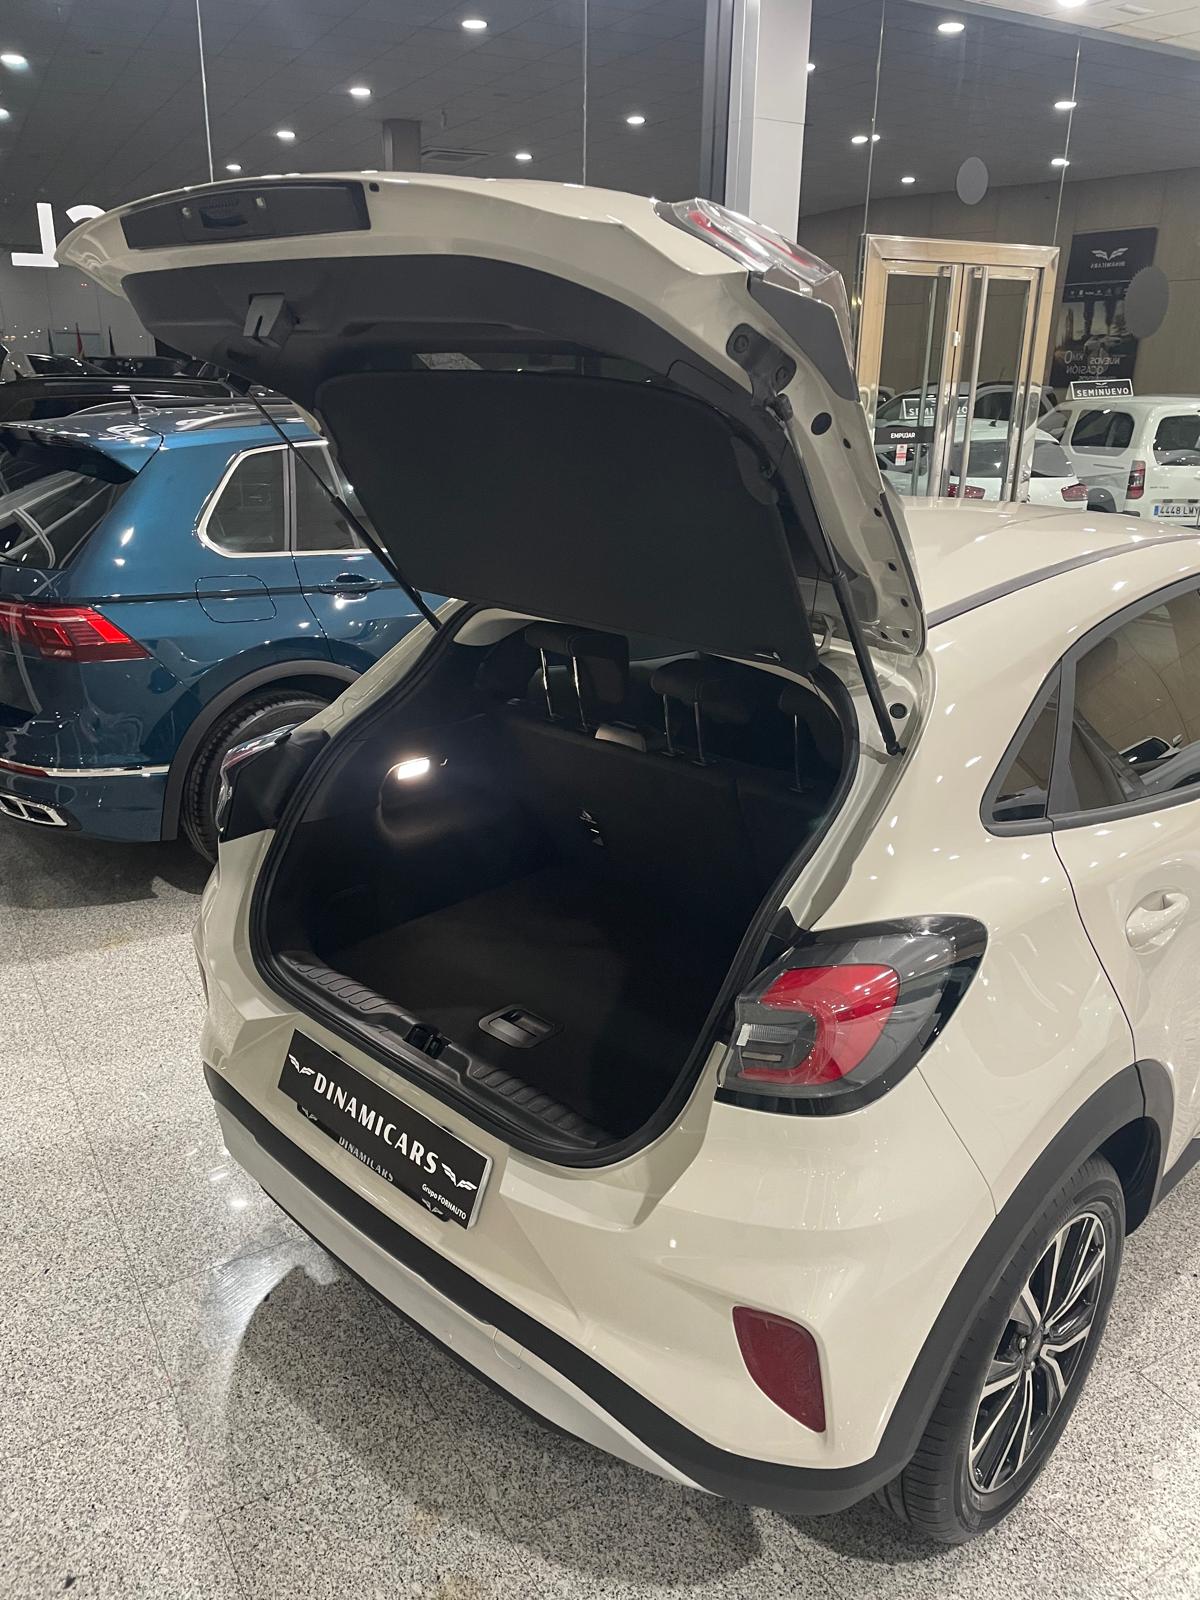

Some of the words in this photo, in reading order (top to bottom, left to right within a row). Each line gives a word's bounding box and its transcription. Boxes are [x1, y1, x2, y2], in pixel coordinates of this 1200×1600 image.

[1076, 387, 1129, 397] SEMINUEVO
[1160, 506, 1181, 515] 4448
[313, 1072, 439, 1174] DINAMICARS
[421, 1183, 438, 1199] Grupo
[437, 1194, 467, 1220] FORNAUTO
